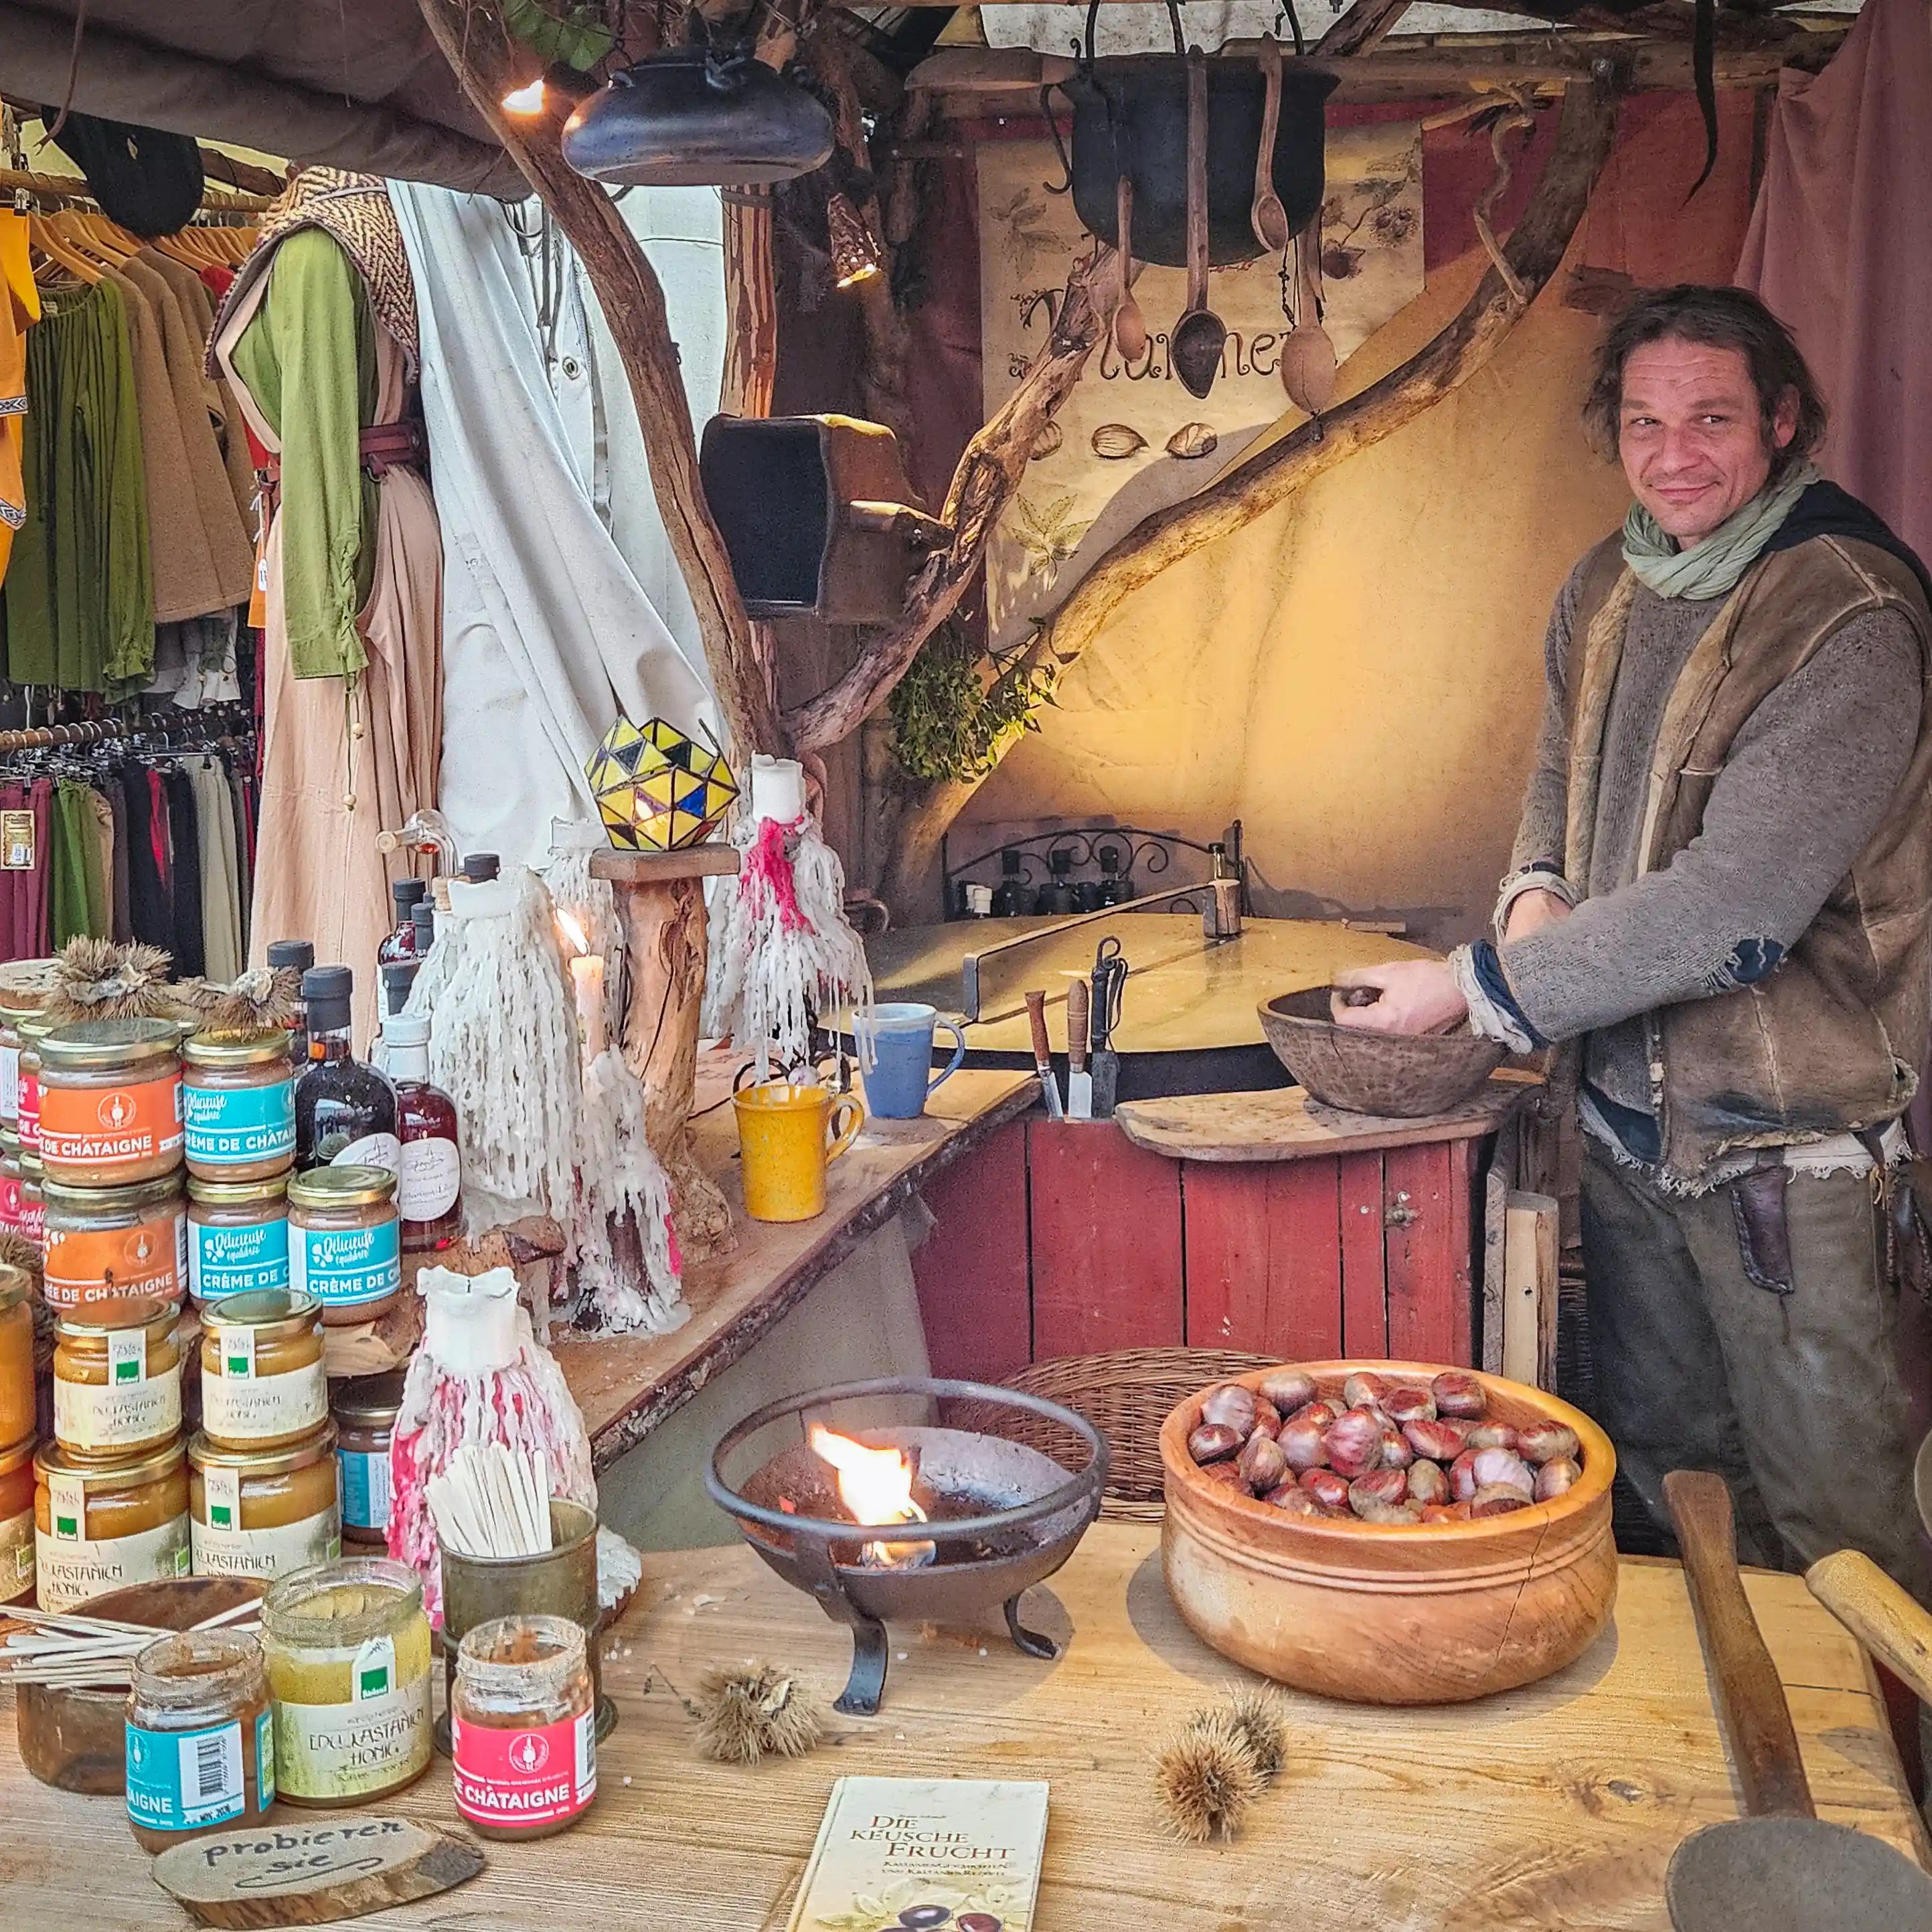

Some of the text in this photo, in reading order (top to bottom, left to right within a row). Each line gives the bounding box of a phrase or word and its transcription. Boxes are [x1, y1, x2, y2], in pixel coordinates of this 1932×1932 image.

[62, 1134, 153, 1157] CHÂTAIGNE
[218, 1138, 241, 1152] DE
[202, 1272, 254, 1290] CRÈME
[258, 1269, 279, 1285] DE
[309, 1277, 362, 1294] CRÈME
[366, 1273, 385, 1289] DE
[62, 1288, 80, 1302] DE
[464, 1783, 570, 1810] CHÂTAIGNE
[870, 1814, 918, 1830] DIE
[850, 1829, 970, 1844] KEUSCHE
[885, 1842, 1016, 1860] FRUCHT
